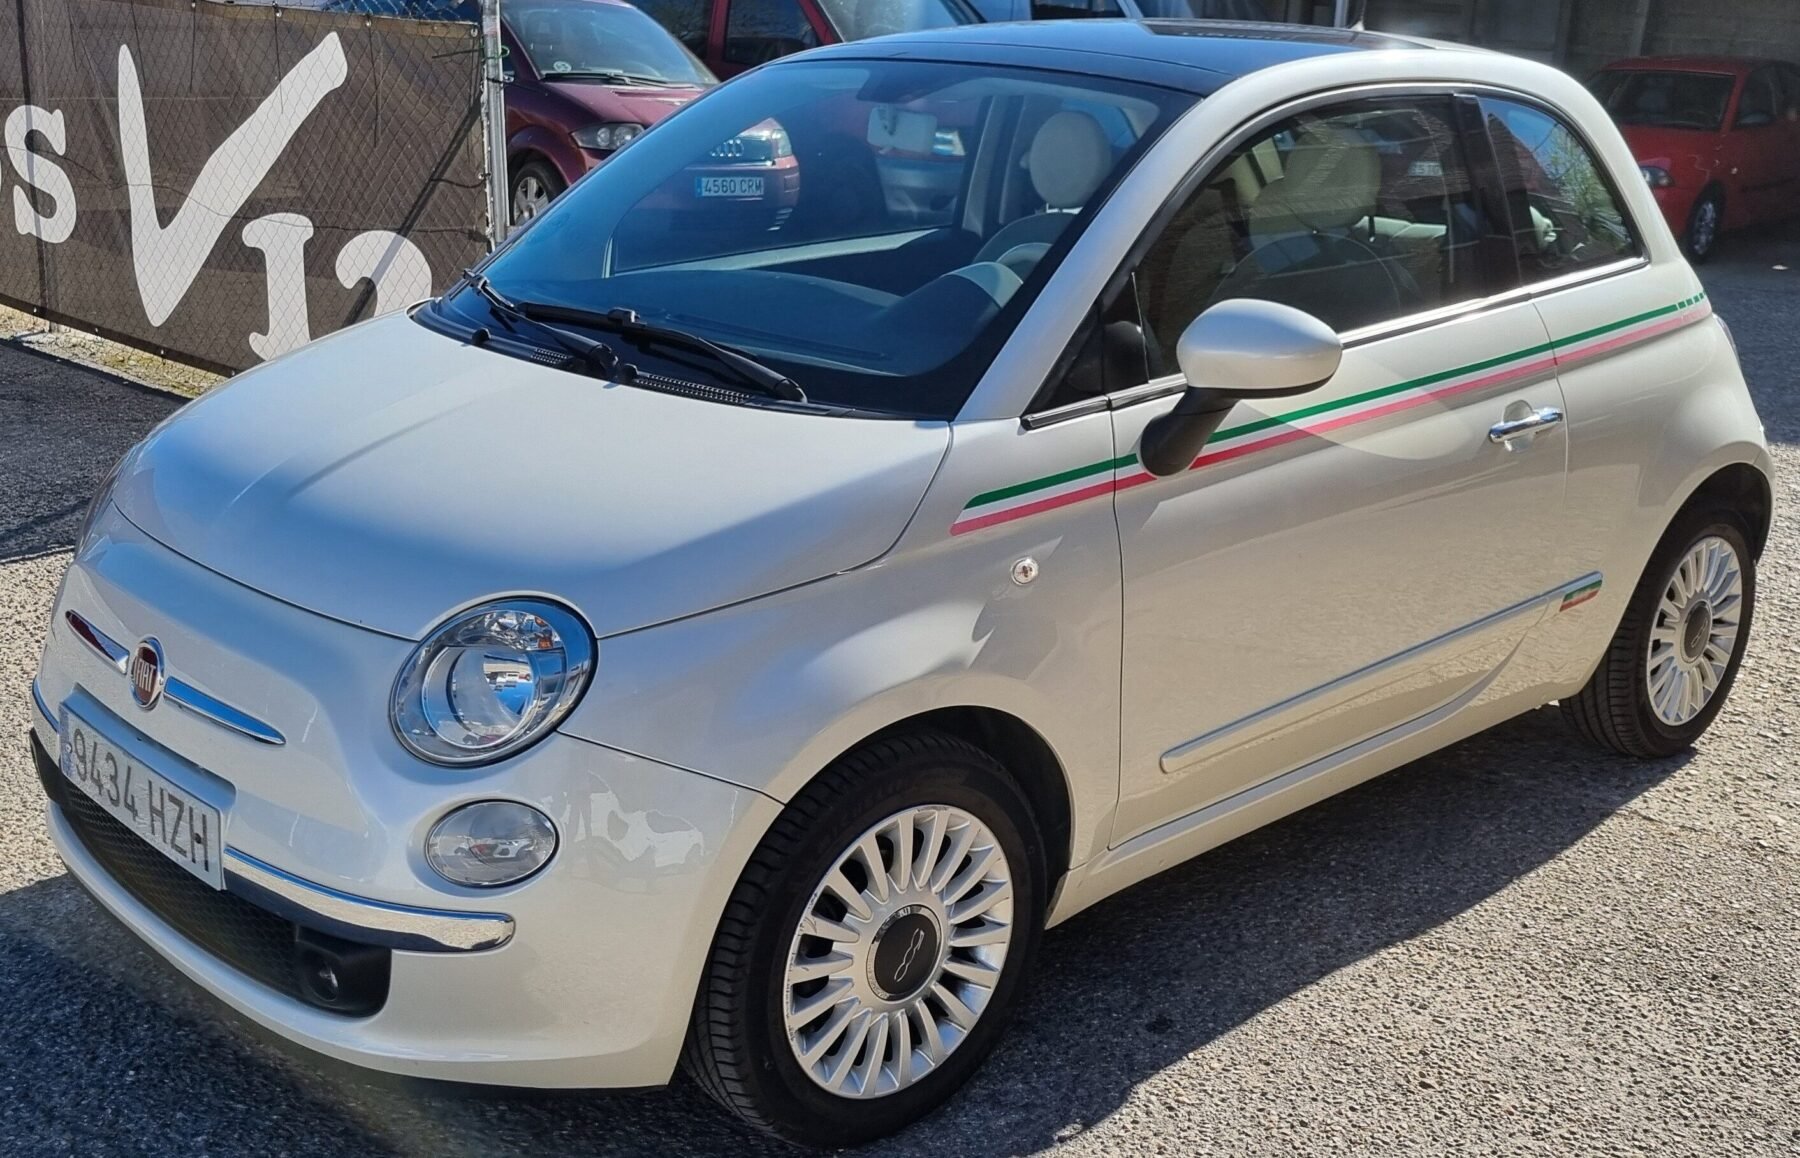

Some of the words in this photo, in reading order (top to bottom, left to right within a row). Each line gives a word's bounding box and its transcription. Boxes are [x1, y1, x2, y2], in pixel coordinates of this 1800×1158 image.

[133, 655, 157, 693] FIAT
[73, 728, 138, 821] 9434
[148, 779, 210, 873] HZH
